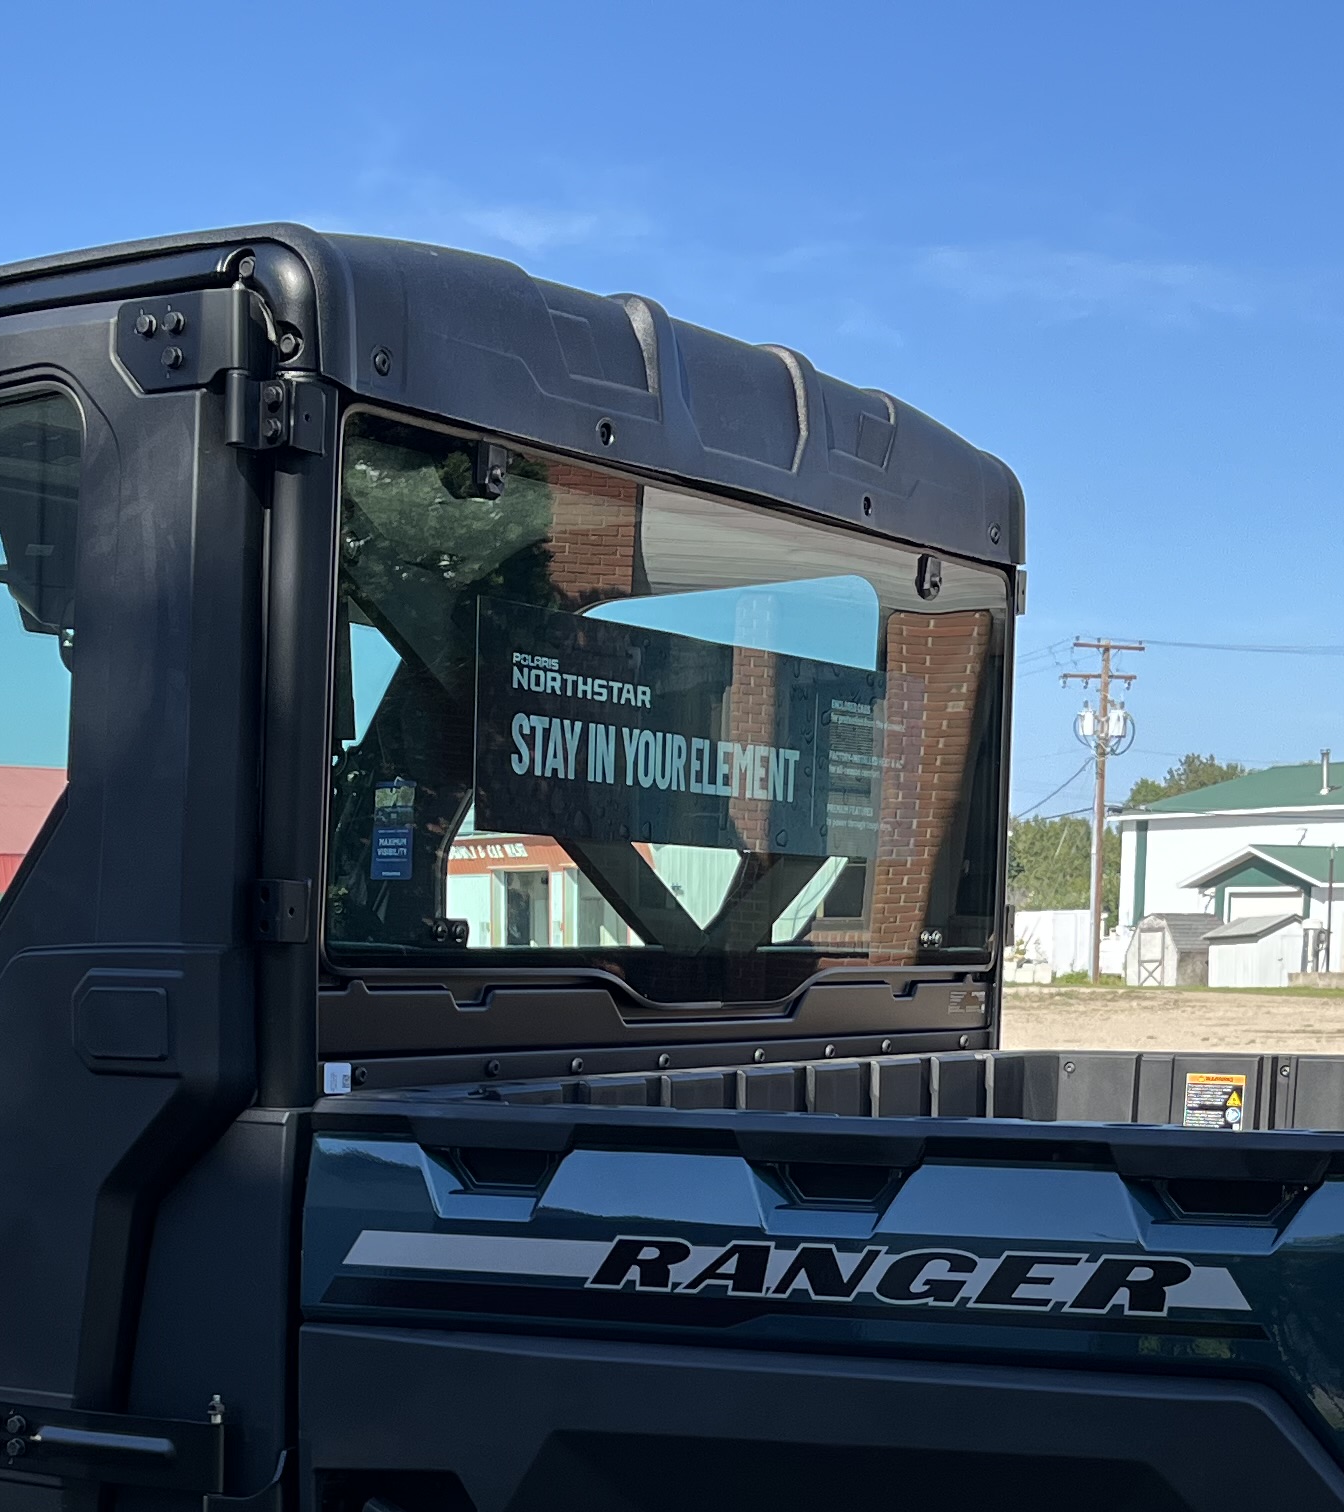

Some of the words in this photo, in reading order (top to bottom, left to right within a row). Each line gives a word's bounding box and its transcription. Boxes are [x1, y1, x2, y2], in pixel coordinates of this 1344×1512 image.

[512, 652, 559, 670] POLARIS
[512, 666, 652, 709] NORTHSTAR
[511, 712, 582, 780] STAY
[587, 722, 616, 784] IN
[621, 726, 687, 792] YOUR
[690, 737, 800, 803] ELEMENT
[584, 1235, 1193, 1317] RANGER
